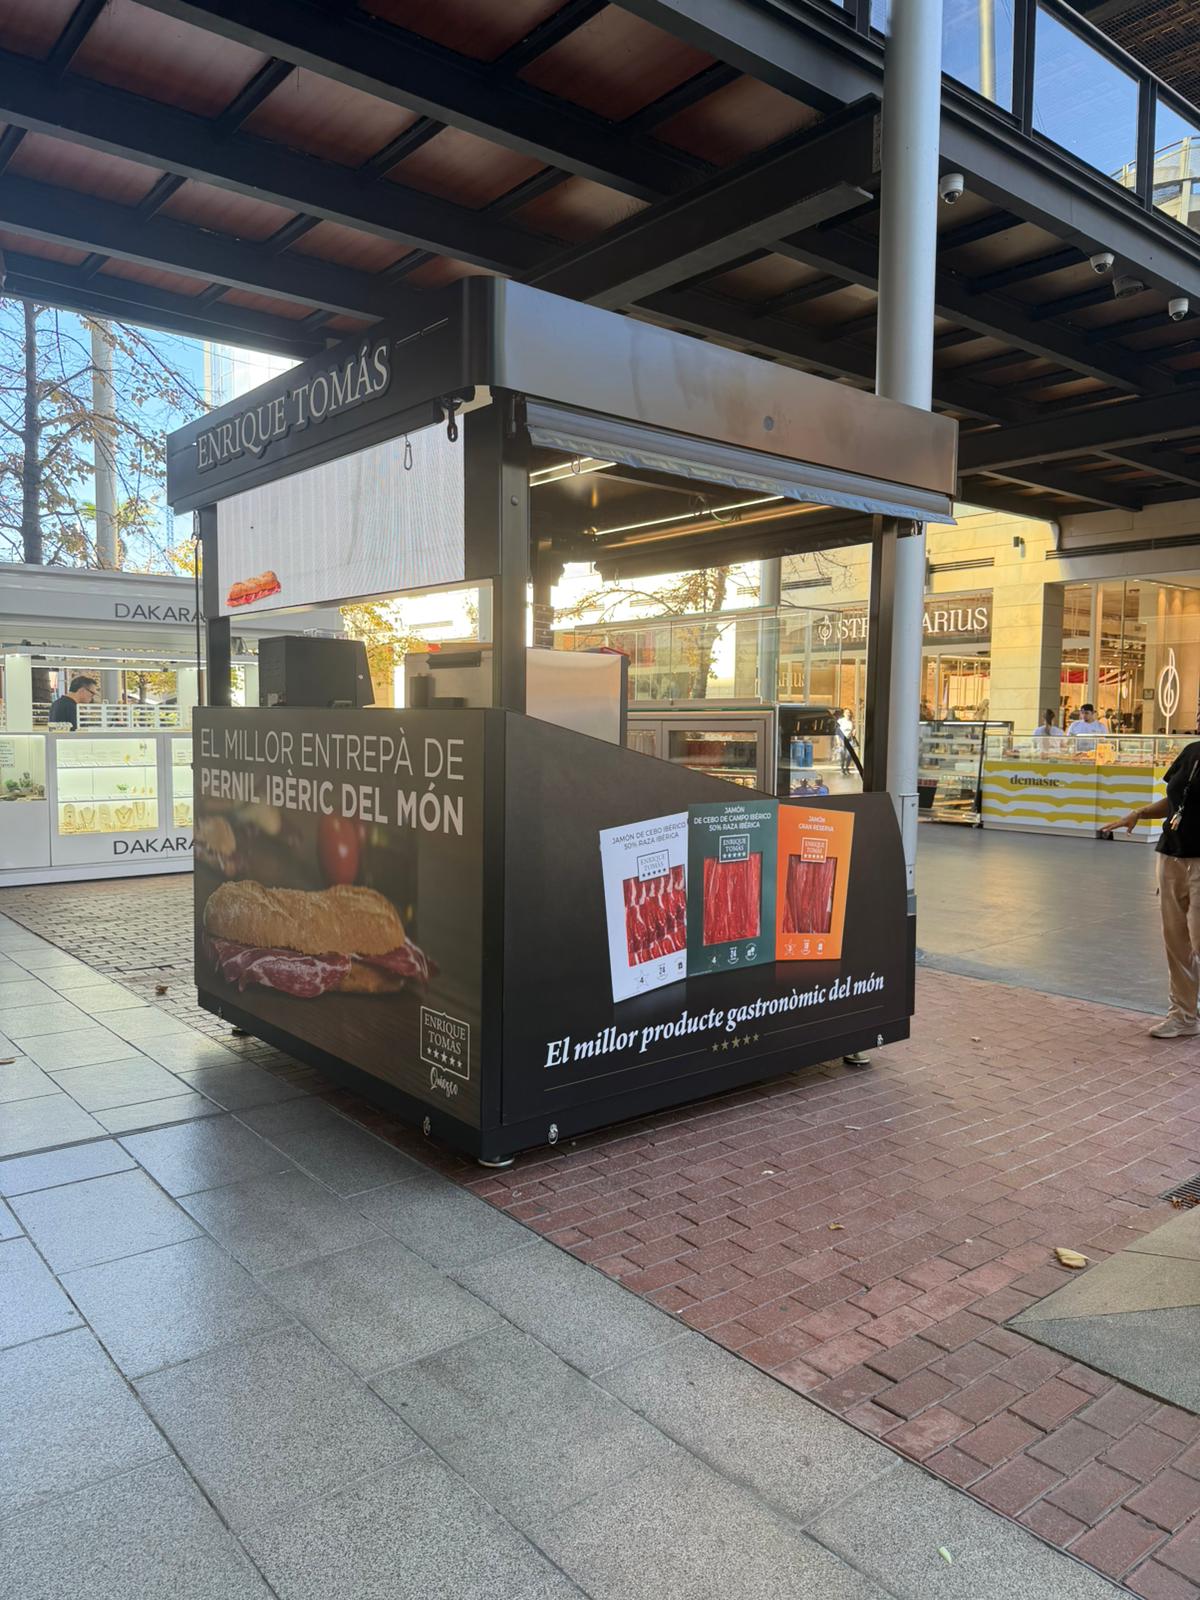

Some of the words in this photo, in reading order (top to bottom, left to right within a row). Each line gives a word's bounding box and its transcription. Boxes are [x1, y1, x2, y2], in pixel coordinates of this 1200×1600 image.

[197, 396, 287, 469] ENRIQUE
[293, 345, 388, 425] TOMÁS
[201, 728, 220, 758] EL
[225, 729, 294, 765] MILLOR
[301, 727, 414, 776] ENTREPÀ
[424, 737, 464, 781] DE
[201, 767, 260, 804] PERNIL
[266, 769, 334, 815] IBÈRIC
[342, 783, 388, 824] DEL
[397, 782, 463, 836] MÓN
[703, 816, 719, 824] CEBO
[612, 832, 635, 844] JAMÓN
[635, 830, 645, 839] DE
[645, 826, 662, 837] CEBO
[638, 837, 655, 846] RAZA
[424, 1013, 466, 1040] ENRIQUE
[544, 1036, 570, 1068] El
[574, 1026, 638, 1061] millor
[639, 1008, 724, 1054] producte
[725, 985, 826, 1032] gastronòmic
[829, 975, 851, 1001] del
[853, 972, 884, 996] món
